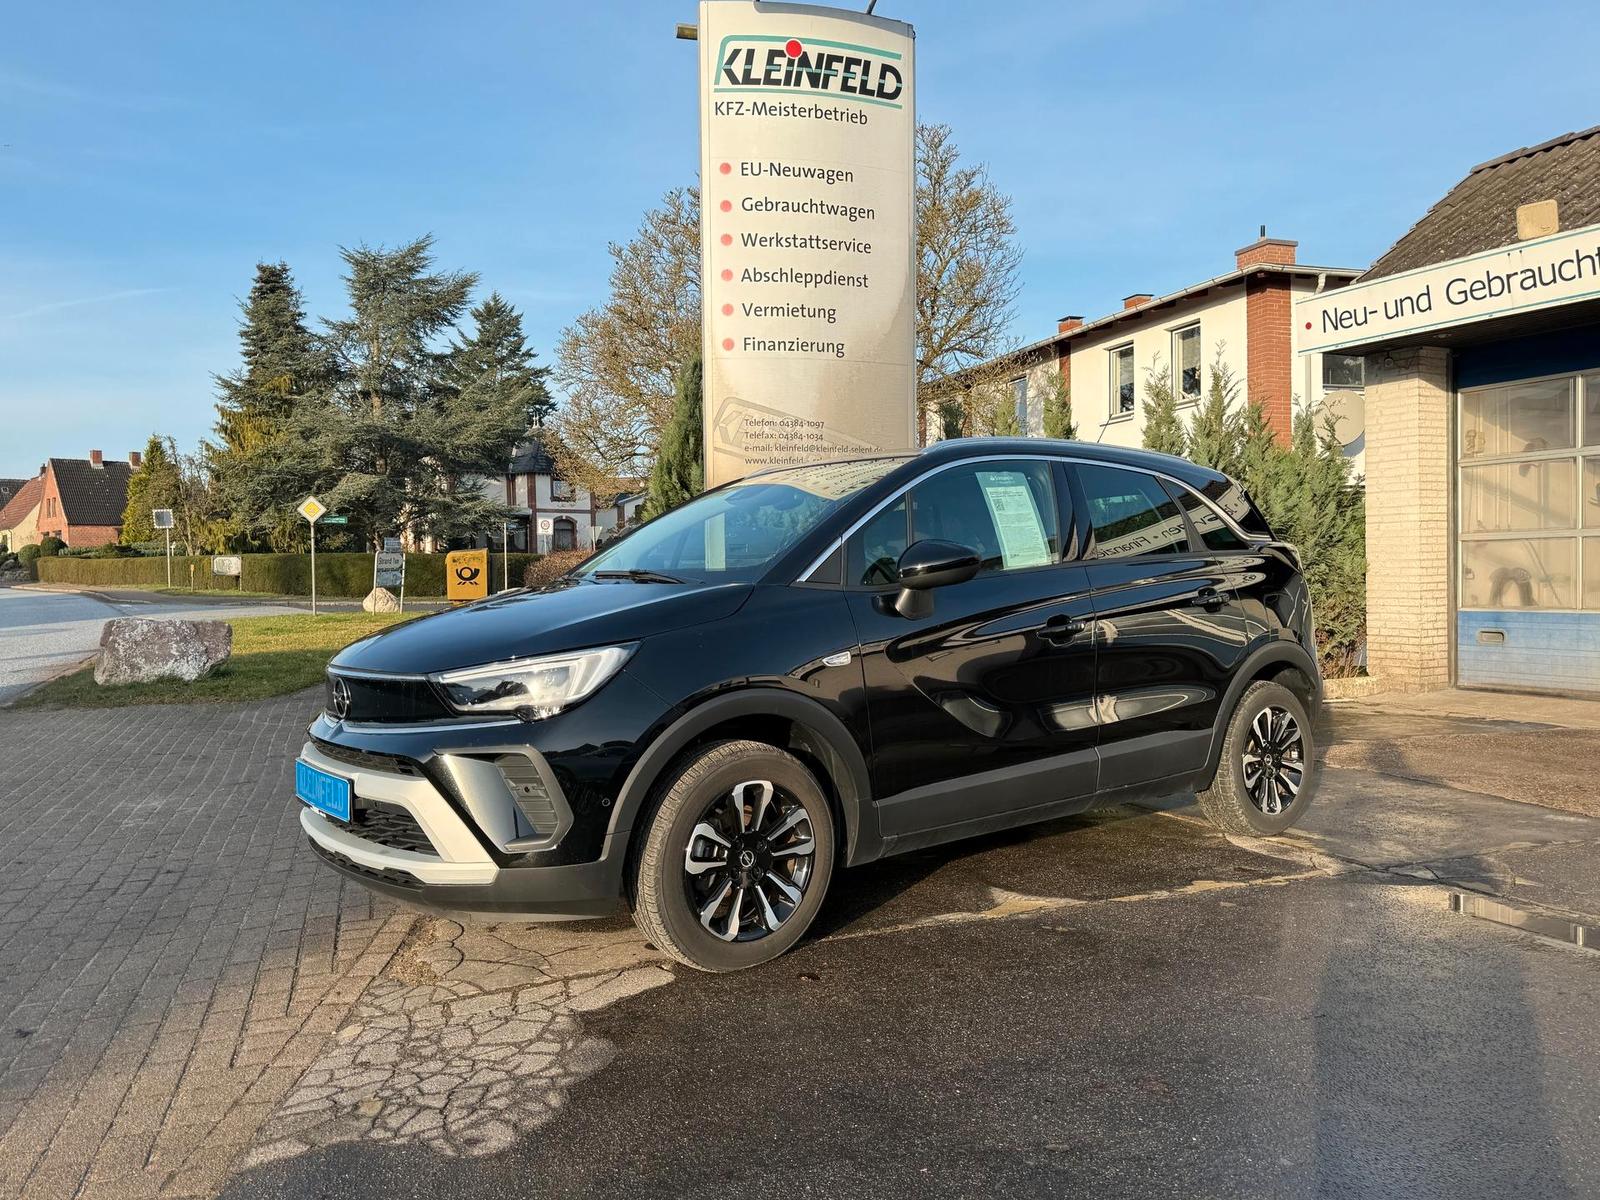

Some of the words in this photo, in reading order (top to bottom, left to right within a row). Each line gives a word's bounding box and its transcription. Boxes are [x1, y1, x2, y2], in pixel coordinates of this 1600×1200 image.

[714, 101, 868, 125] KFZ-Meisterbetrieb
[740, 162, 854, 185] EU-Neuwagen
[741, 197, 875, 222] Gebrauchtwagen
[740, 232, 872, 254] Werkstattservice
[740, 267, 869, 288] Abschleppdienst
[741, 303, 837, 323] Vermietung
[743, 337, 845, 358] Finanzierung
[744, 419, 778, 427] Telefon:
[744, 431, 777, 439] Telefax:
[744, 443, 773, 452] e-mail:
